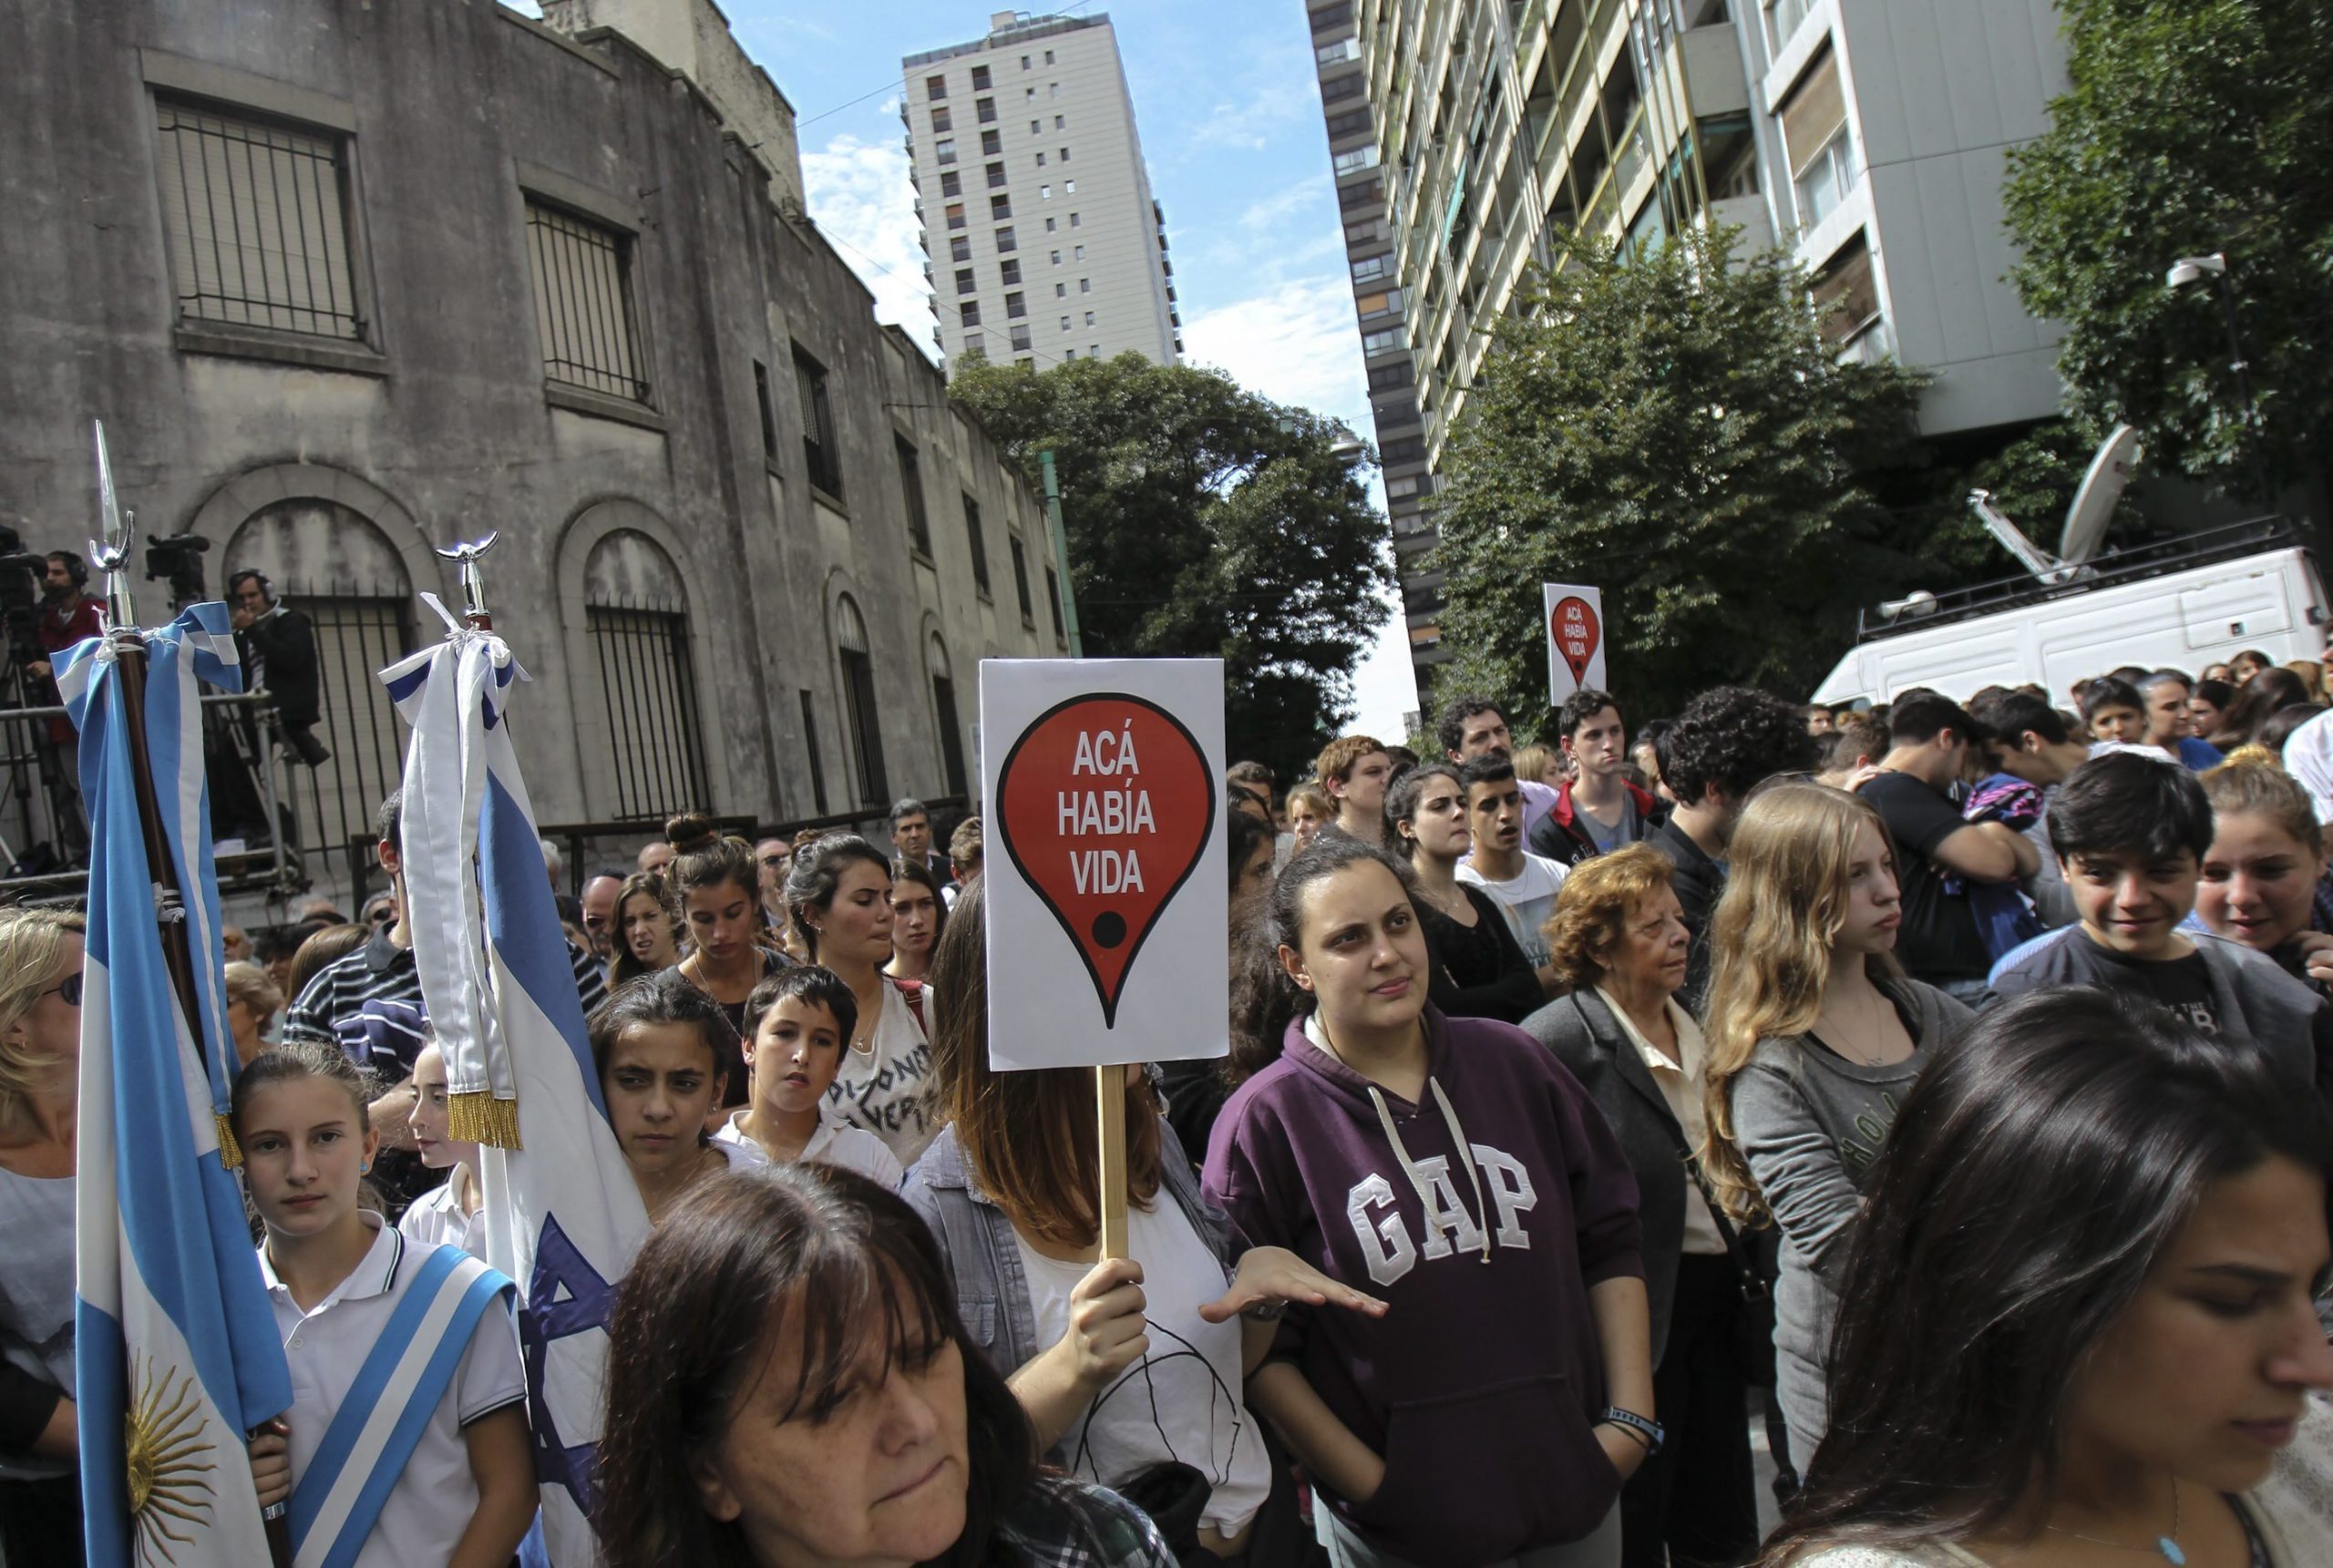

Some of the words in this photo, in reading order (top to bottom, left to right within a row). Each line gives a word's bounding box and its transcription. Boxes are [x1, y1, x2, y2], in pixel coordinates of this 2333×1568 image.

[1565, 621, 1588, 639] HABÍA
[1567, 604, 1583, 620] ACÁ
[1567, 641, 1586, 656] VIDA
[1073, 718, 1139, 776] ACÁ
[1058, 779, 1156, 835] HABÍA
[1070, 849, 1145, 895] VIDA
[1347, 1143, 1537, 1286] GAP
